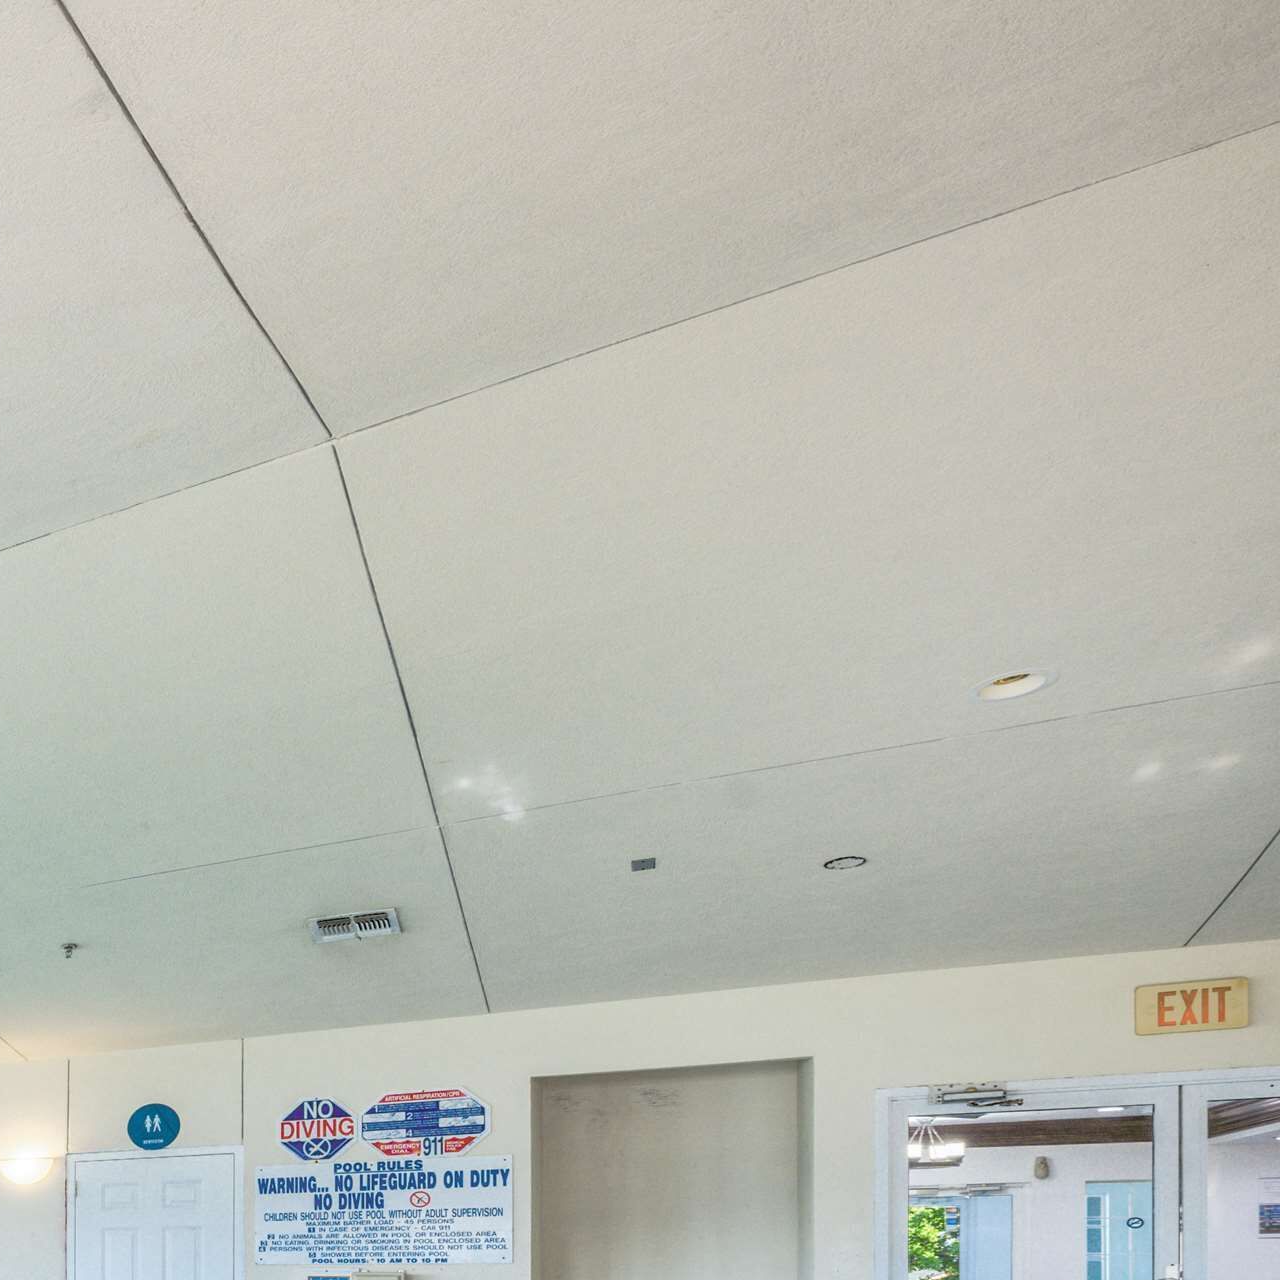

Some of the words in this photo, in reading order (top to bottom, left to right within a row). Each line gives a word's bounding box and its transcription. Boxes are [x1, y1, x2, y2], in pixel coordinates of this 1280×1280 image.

[1157, 986, 1232, 1027] EXIT
[303, 1100, 333, 1119] NO
[280, 1117, 355, 1140] DIVING
[423, 1137, 444, 1156] 911
[333, 1162, 371, 1172] POOL
[377, 1160, 423, 1171] RULES
[257, 1176, 329, 1195] WARNING...
[335, 1175, 353, 1192] NO
[360, 1172, 437, 1191] LIFEGUARD
[443, 1170, 464, 1188] ON
[470, 1168, 510, 1187] DUTY
[314, 1193, 333, 1210] NO
[338, 1192, 385, 1210] DIVING
[264, 1212, 298, 1222] CHILDREN
[300, 1211, 329, 1221] SHOULD
[331, 1211, 346, 1220] NOT
[349, 1211, 363, 1220] USE
[366, 1210, 386, 1219] POOL
[388, 1209, 422, 1218] WITHOUT
[425, 1208, 449, 1218] ADULT
[451, 1207, 504, 1217] SUPERVISION
